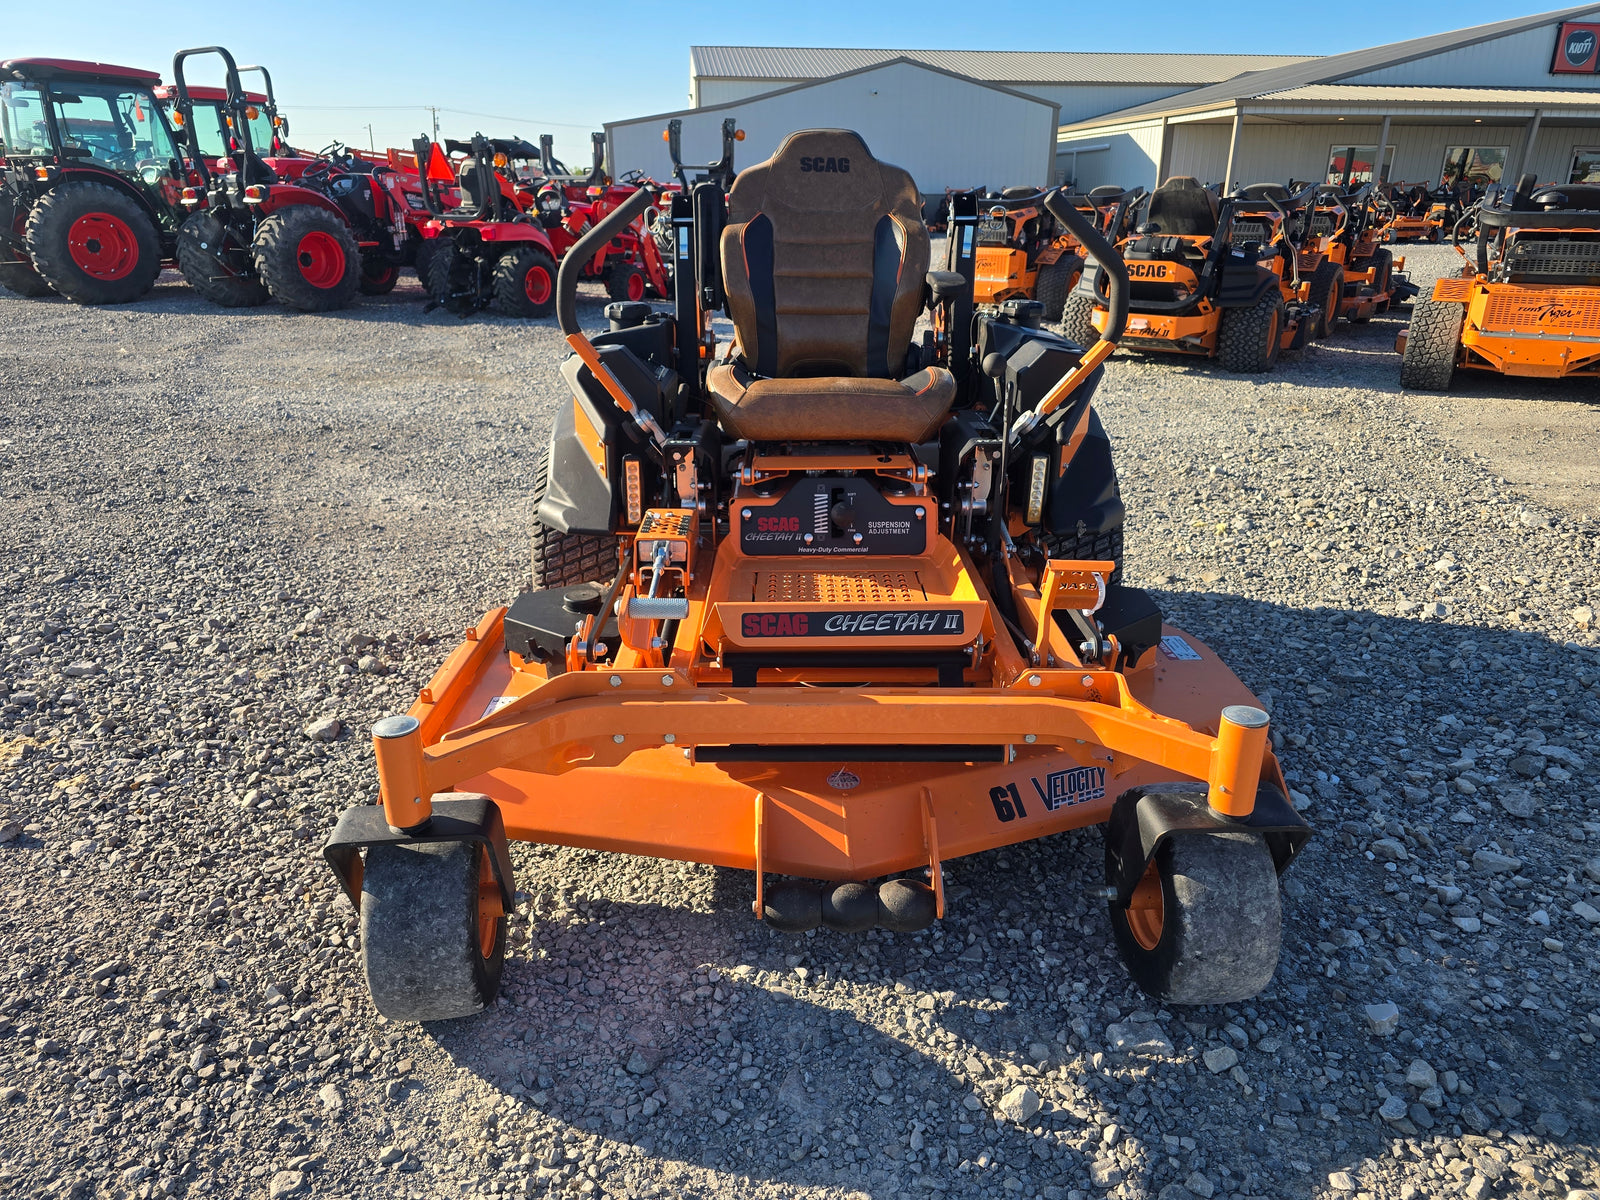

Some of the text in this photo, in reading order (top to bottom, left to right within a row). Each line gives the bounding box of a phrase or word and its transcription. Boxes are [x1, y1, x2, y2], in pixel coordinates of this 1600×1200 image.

[1568, 40, 1592, 54] KIOTI
[800, 157, 850, 173] SCAG
[1126, 263, 1167, 278] SCAG
[757, 517, 800, 532] SCAG
[868, 521, 911, 529] SUSPENSION
[745, 532, 802, 541] CHEETAH II
[744, 612, 960, 636] SCAG CHEETAH II
[989, 766, 1106, 822] 61 VELOCITY
[1053, 788, 1105, 810] PLUS
